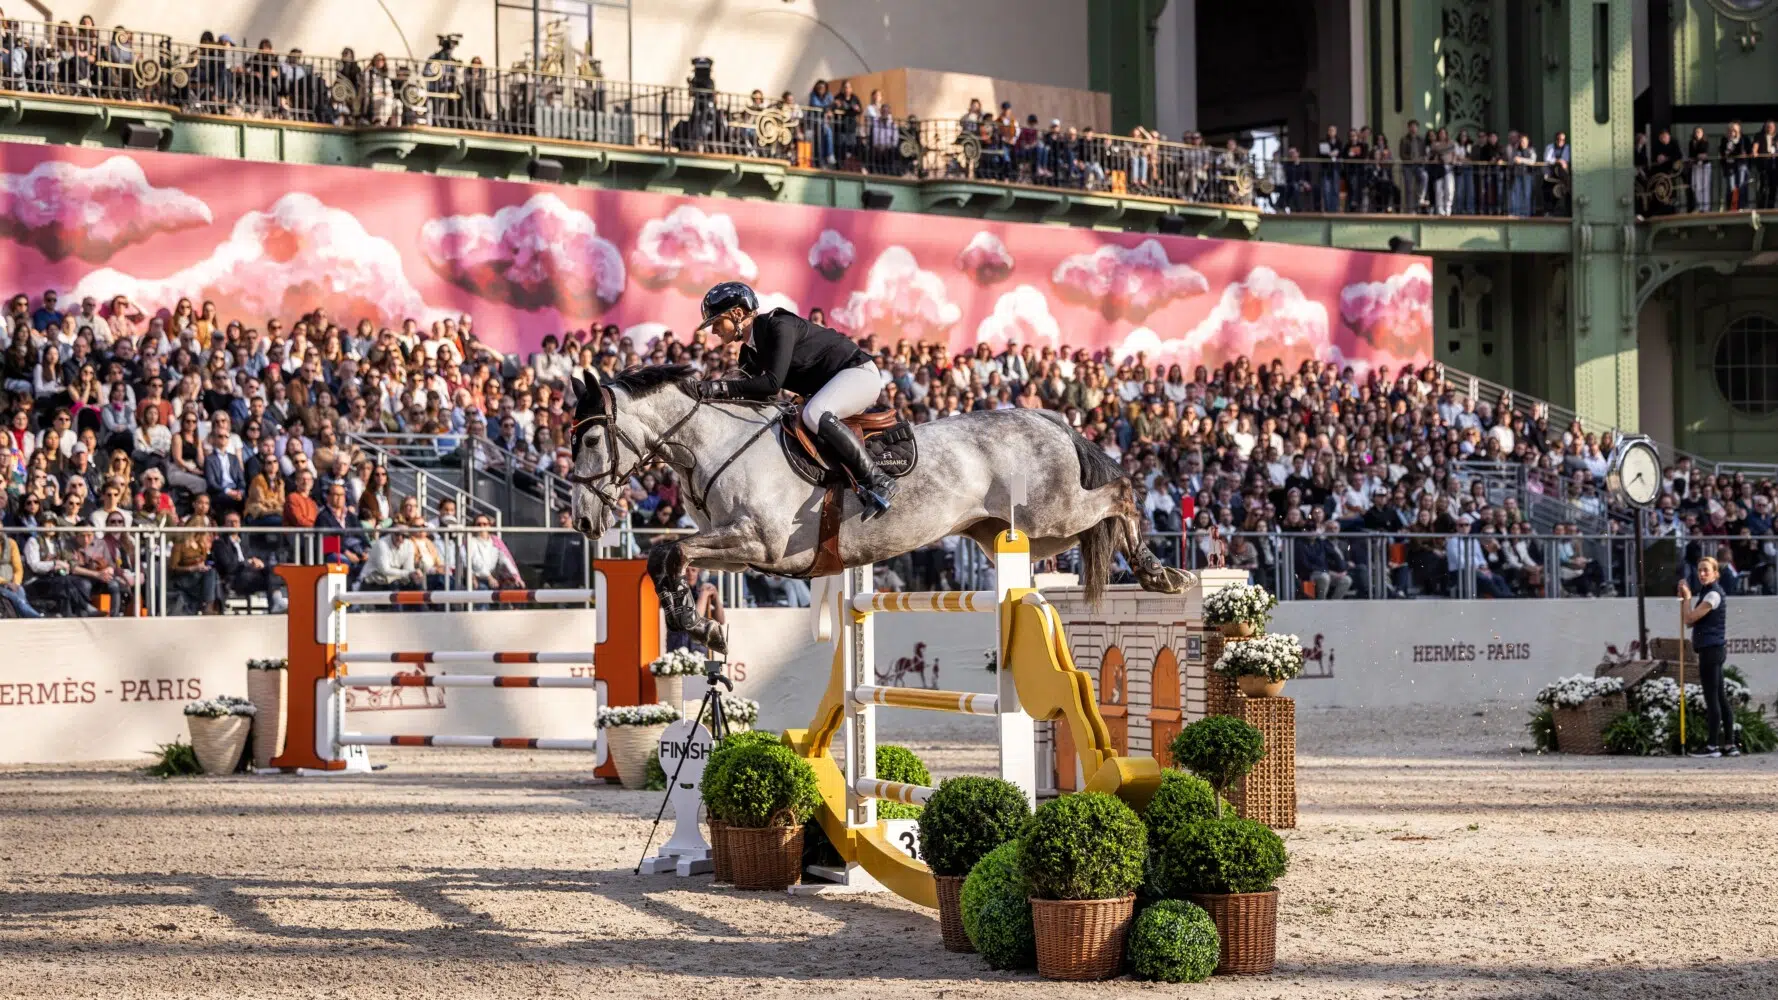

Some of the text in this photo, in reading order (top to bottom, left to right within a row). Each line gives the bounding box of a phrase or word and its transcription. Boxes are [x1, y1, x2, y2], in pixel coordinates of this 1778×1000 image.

[1413, 641, 1476, 662] HERMÈS
[1487, 643, 1530, 660] PARIS
[0, 677, 96, 706] ERMÈS
[120, 678, 201, 702] PARIS
[660, 741, 713, 760] FINISH
